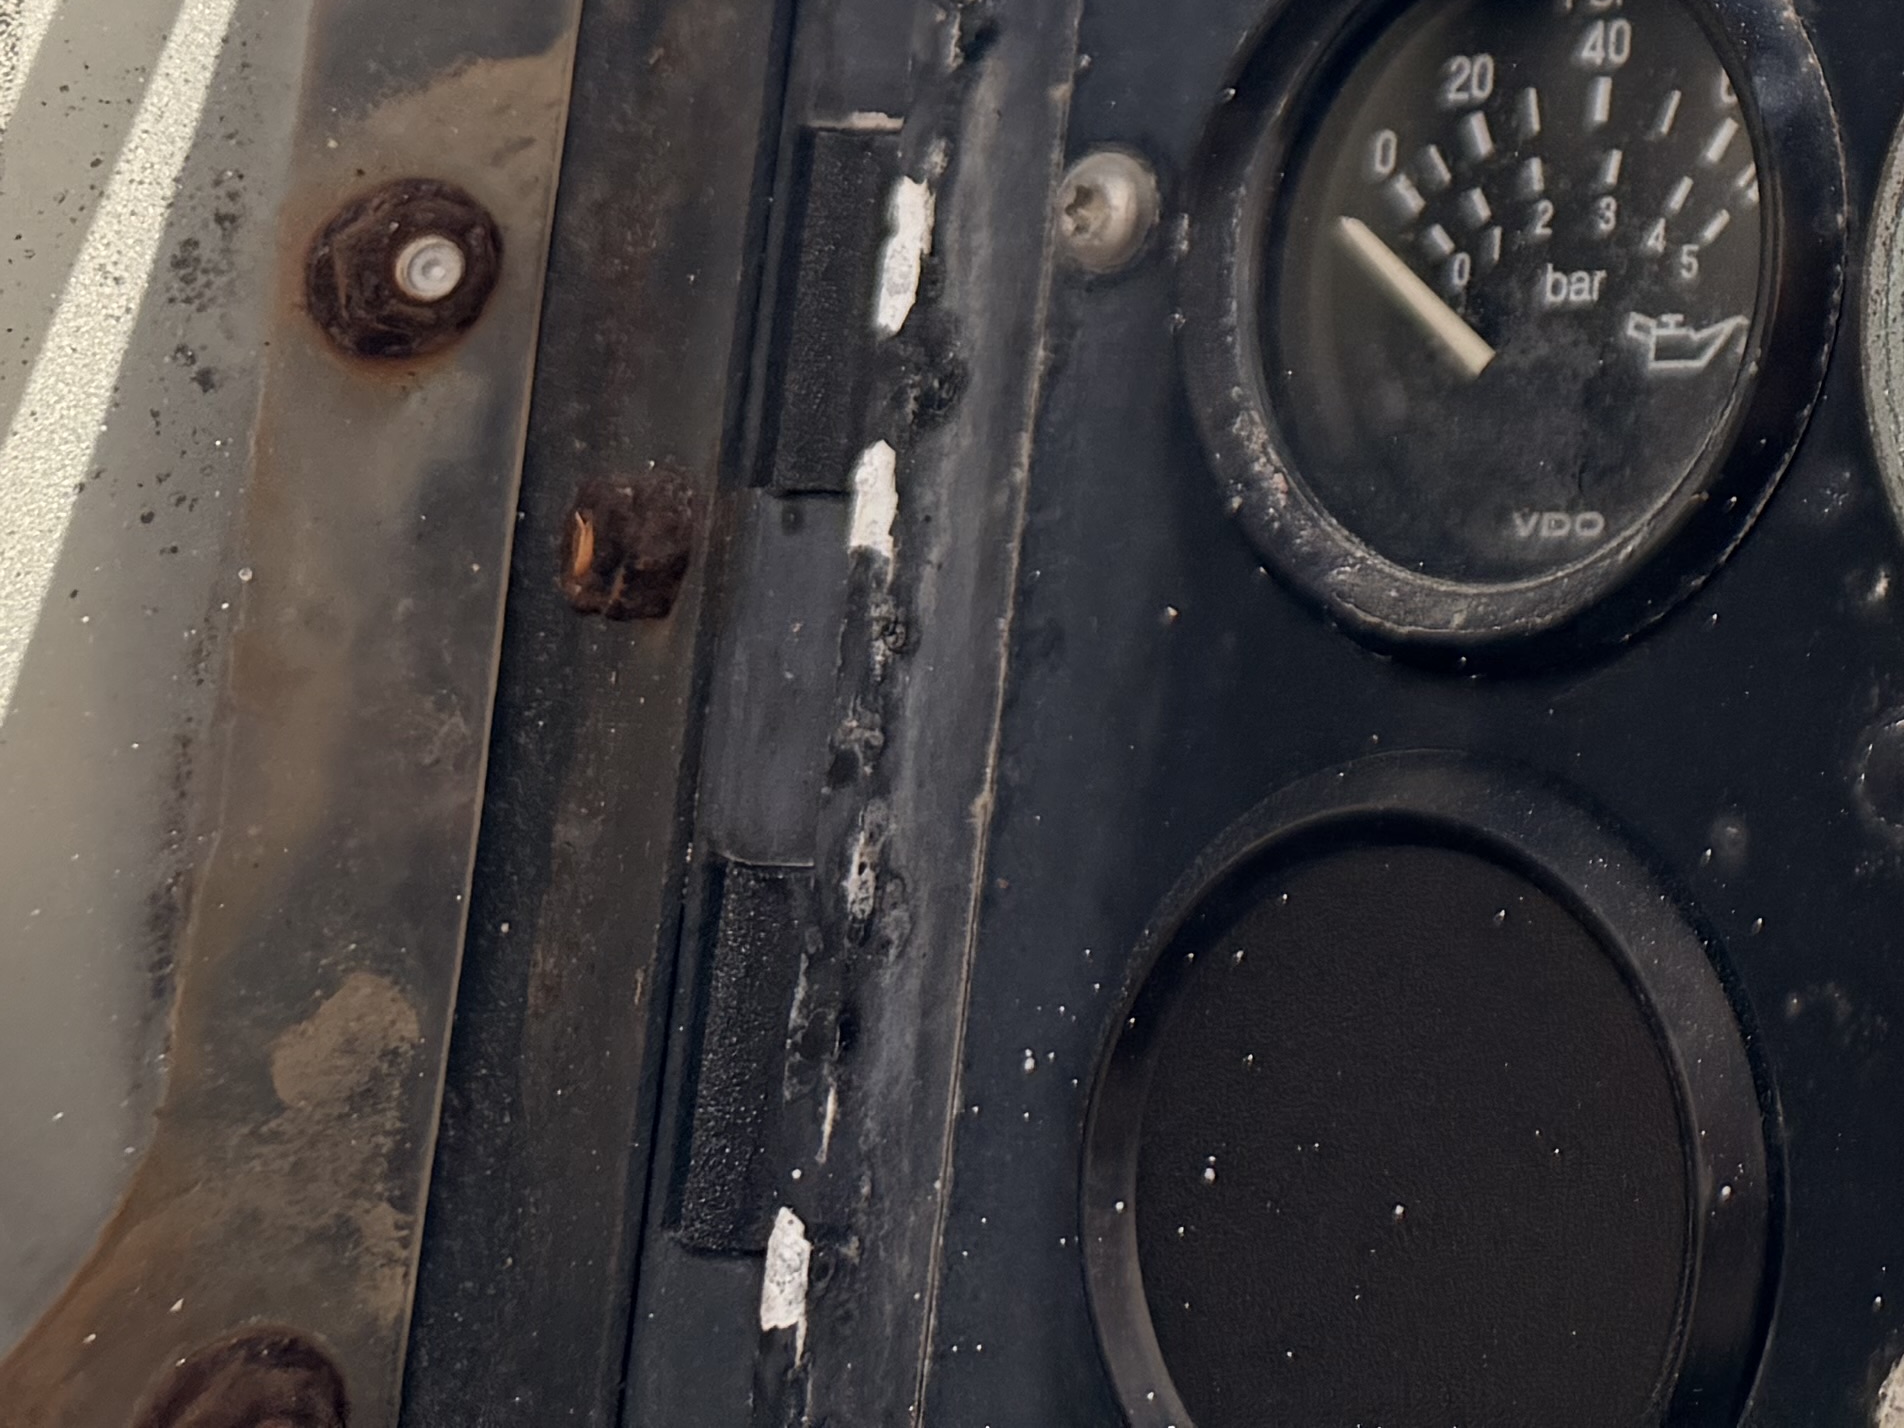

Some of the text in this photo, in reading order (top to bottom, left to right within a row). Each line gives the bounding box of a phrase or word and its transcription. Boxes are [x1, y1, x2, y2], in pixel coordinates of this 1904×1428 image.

[1583, 19, 1632, 65] 40
[1449, 53, 1495, 101] 20
[1374, 129, 1397, 175] 0
[1534, 200, 1554, 235] 2
[1600, 197, 1617, 231] 3
[1647, 218, 1666, 253] 4
[1453, 253, 1470, 286] 0
[1680, 244, 1699, 279] 5
[1545, 263, 1605, 303] bar
[1512, 512, 1603, 538] VDO
